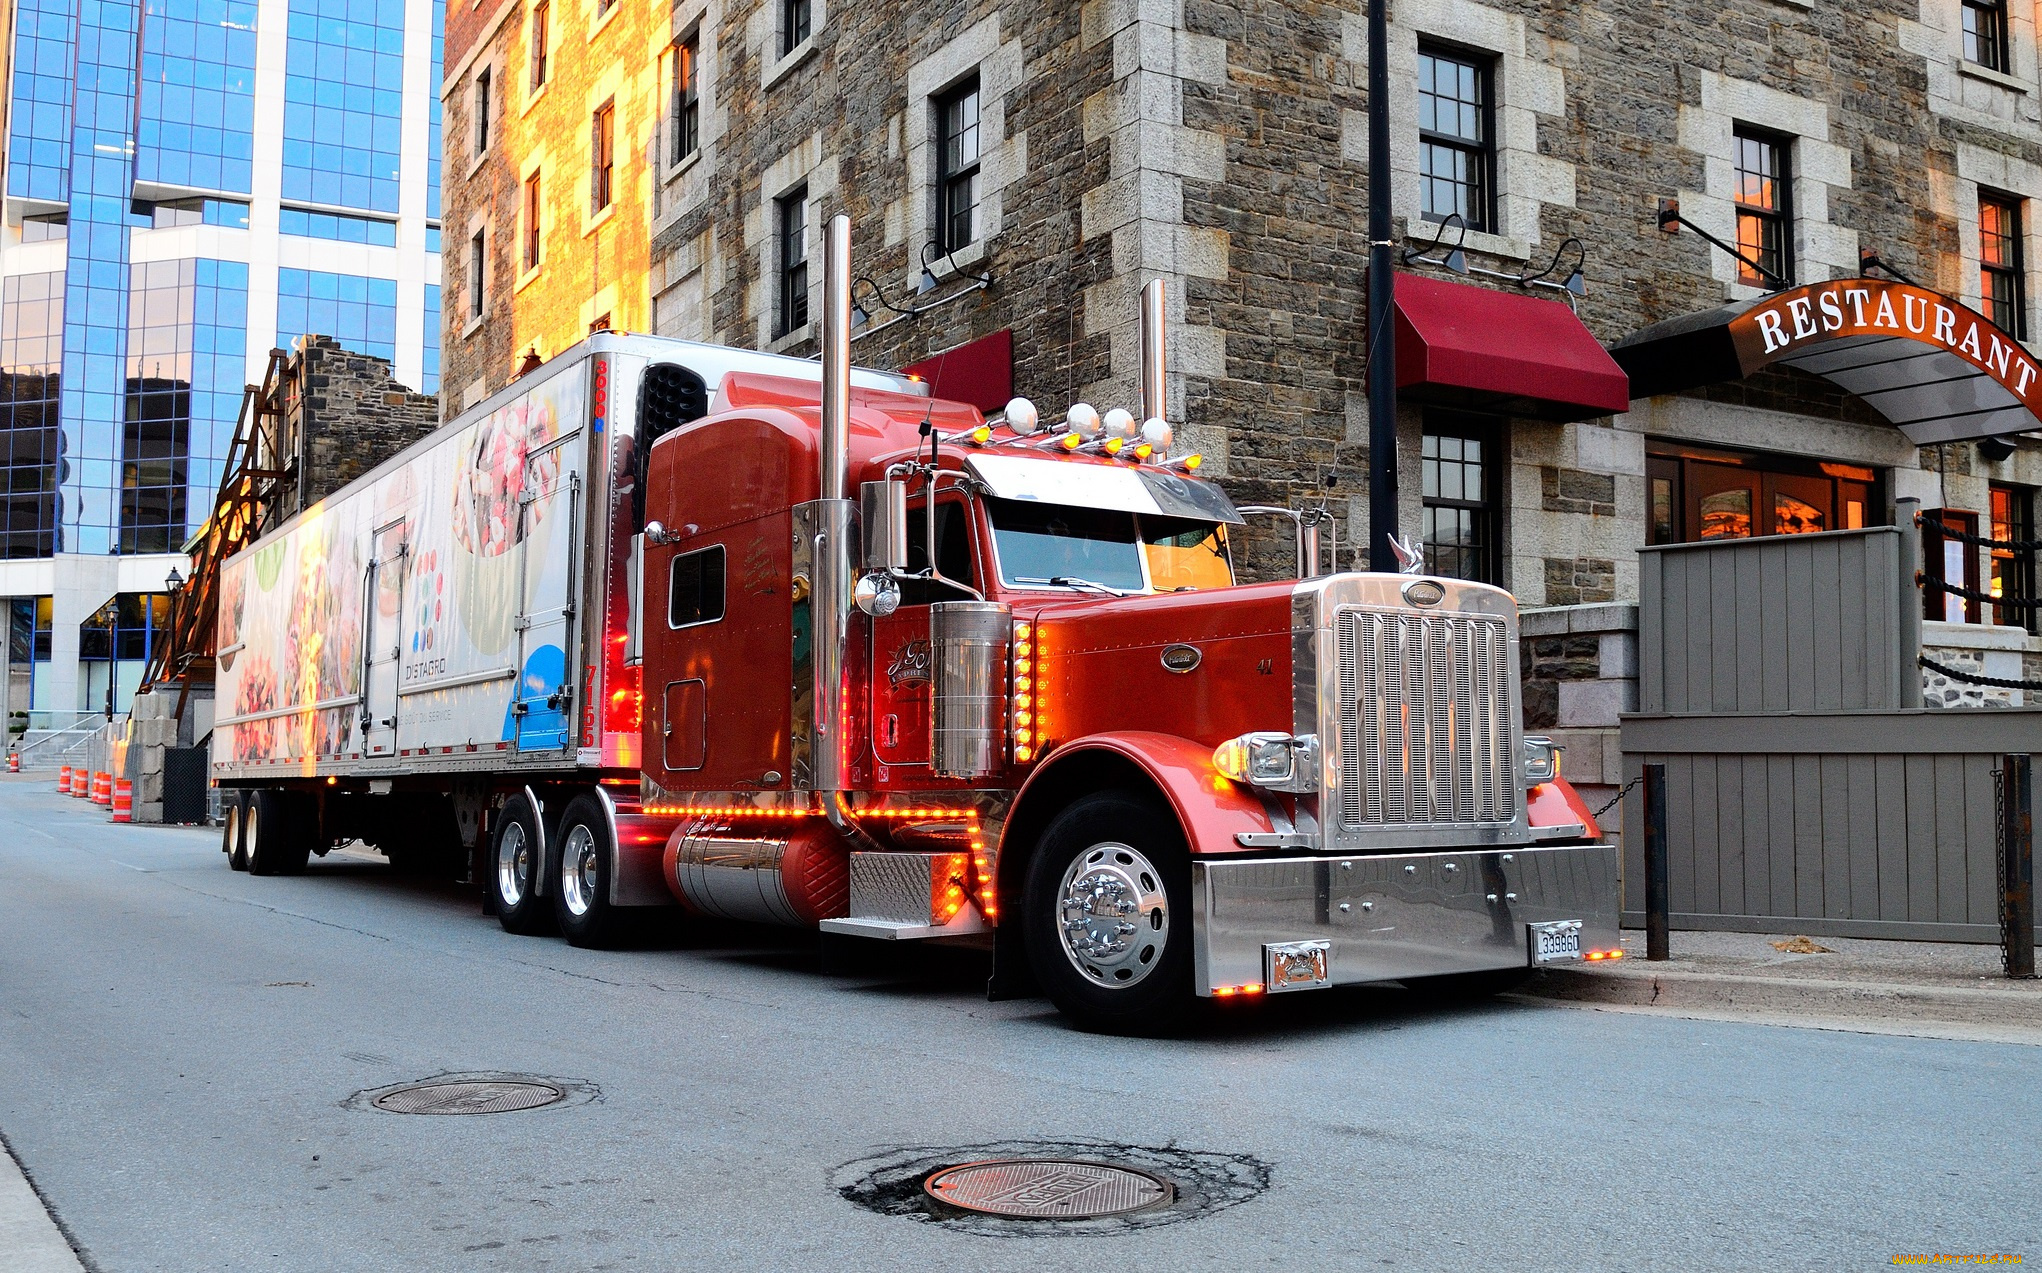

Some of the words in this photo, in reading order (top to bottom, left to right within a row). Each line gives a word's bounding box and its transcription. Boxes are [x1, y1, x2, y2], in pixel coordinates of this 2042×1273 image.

[1754, 288, 2038, 398] RESTAURANT
[405, 657, 446, 680] DISTAGRO
[1256, 658, 1273, 676] 41
[583, 665, 597, 748] 7155
